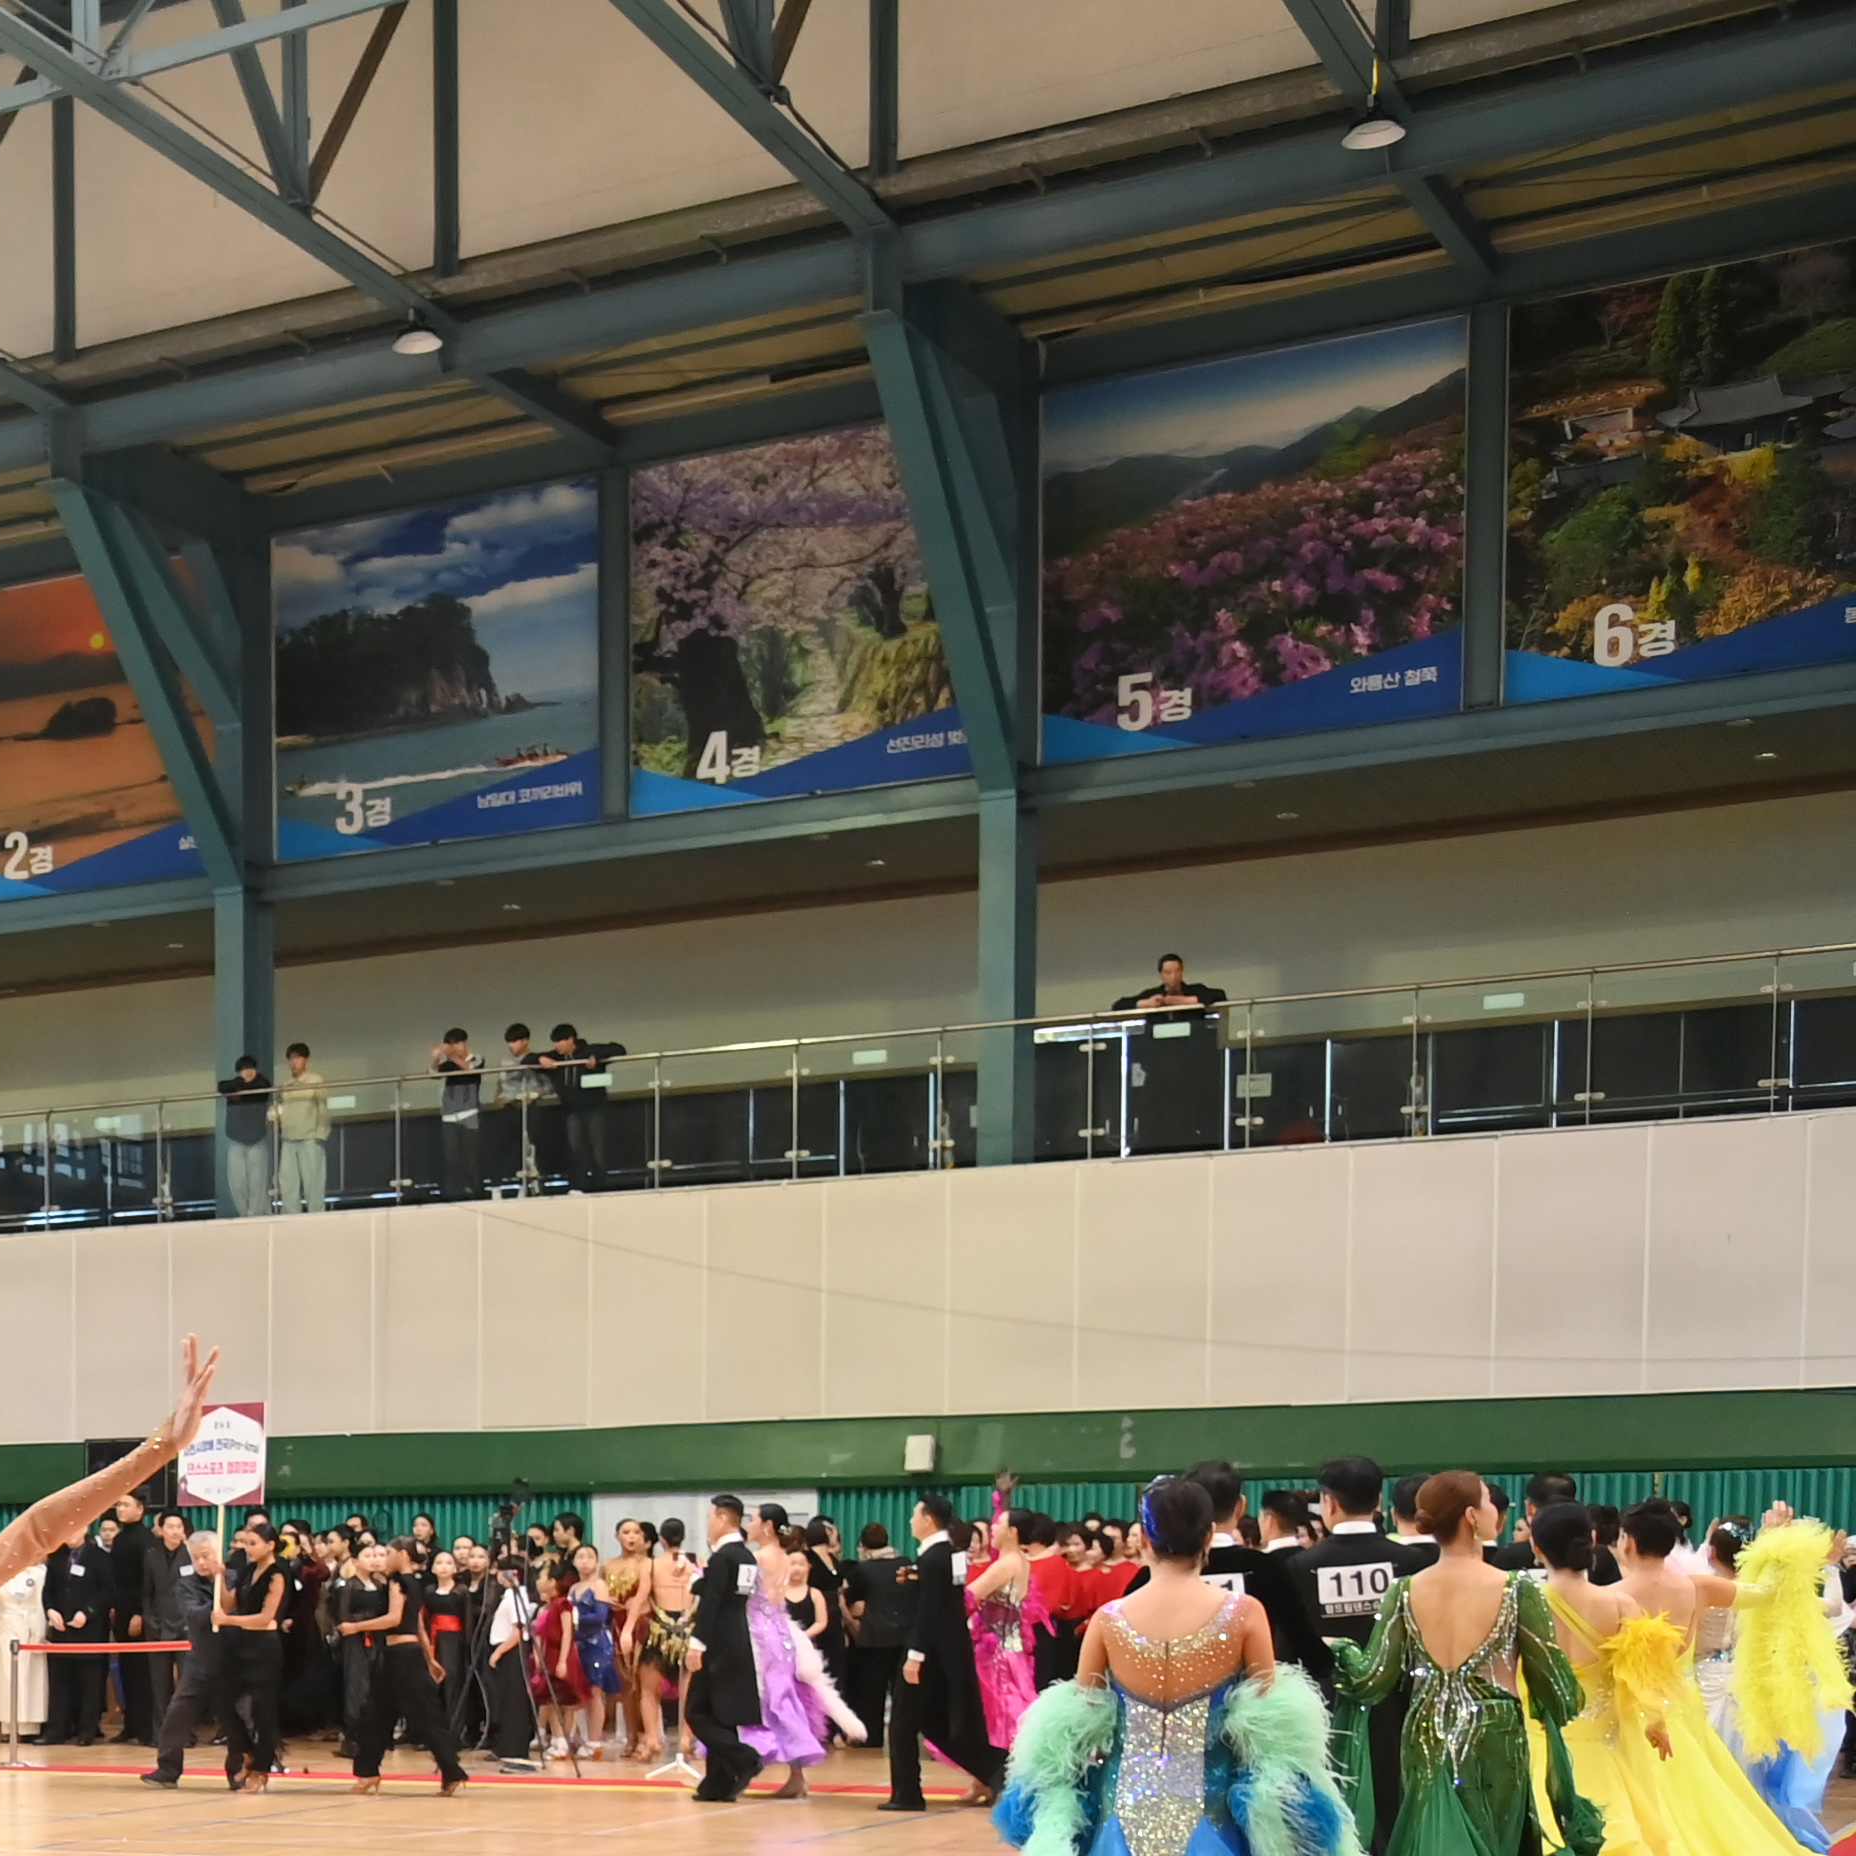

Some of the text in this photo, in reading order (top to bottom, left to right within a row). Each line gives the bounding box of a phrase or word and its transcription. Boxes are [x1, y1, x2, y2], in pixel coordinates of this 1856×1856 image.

[1593, 603, 1676, 667] 6경
[1117, 672, 1192, 732] 5경
[696, 730, 761, 785] 4경
[335, 784, 392, 835] 3경
[4, 831, 53, 880] 2경
[1329, 1568, 1389, 1598] 110
